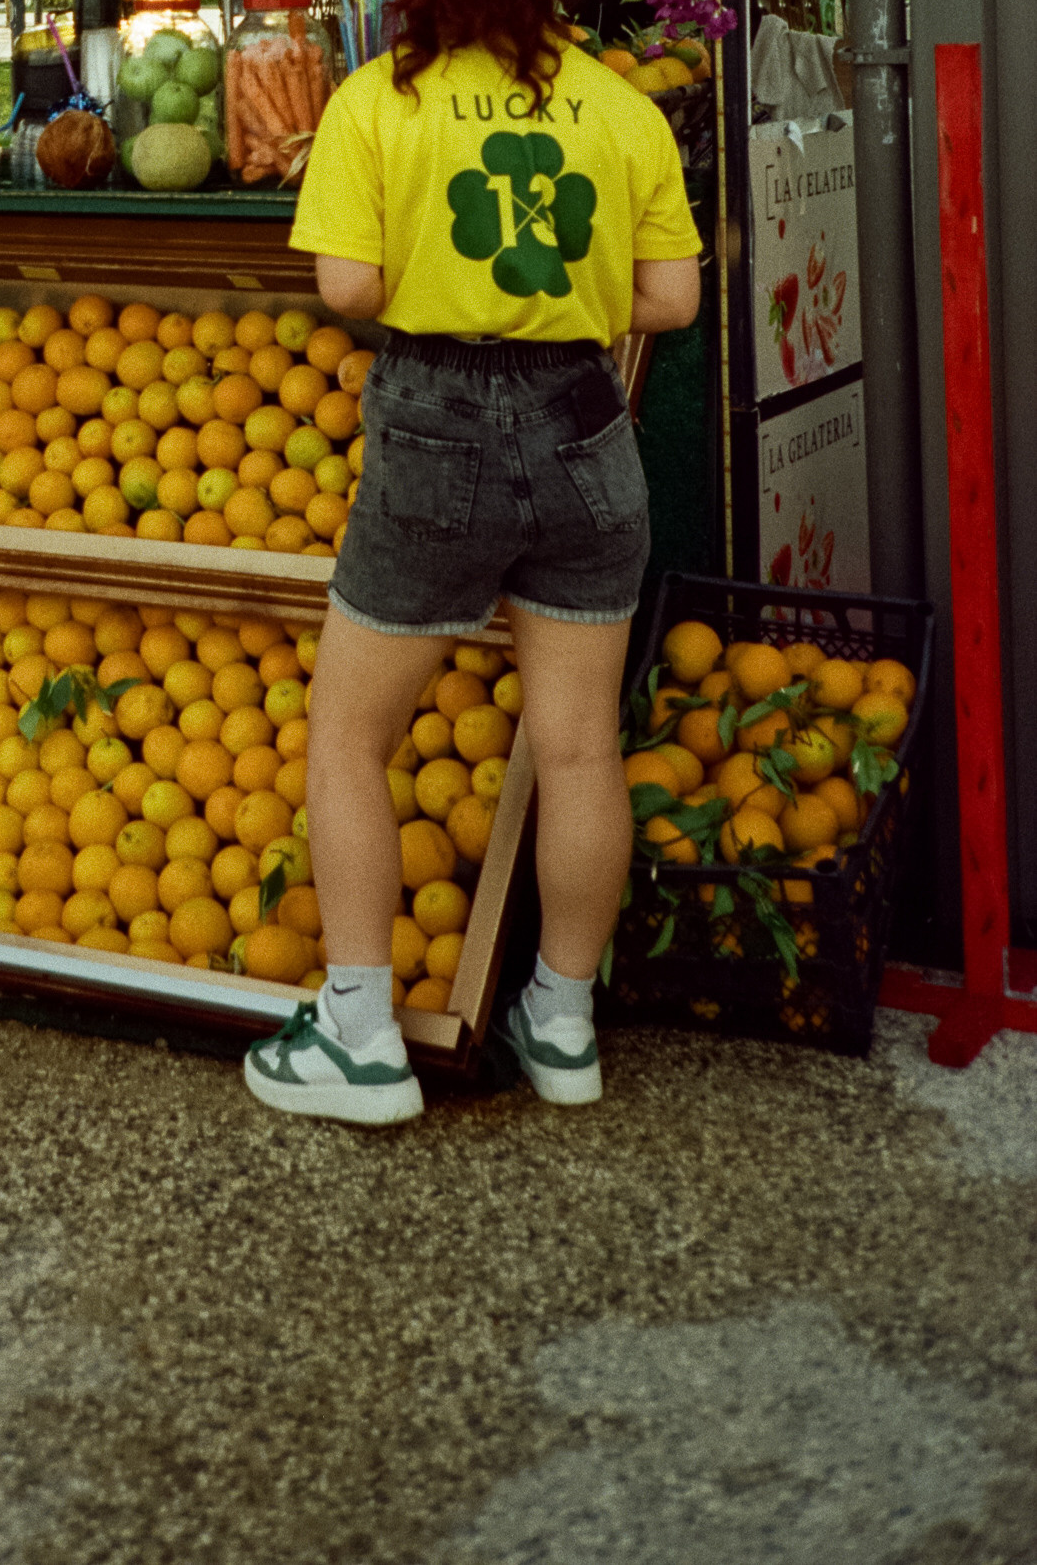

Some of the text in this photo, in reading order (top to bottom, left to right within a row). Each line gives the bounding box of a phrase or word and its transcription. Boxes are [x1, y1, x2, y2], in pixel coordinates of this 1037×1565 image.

[451, 92, 583, 124] LUCKY
[485, 173, 559, 248] 13
[774, 178, 792, 204] LA
[769, 412, 853, 474] LA GELATERIA
